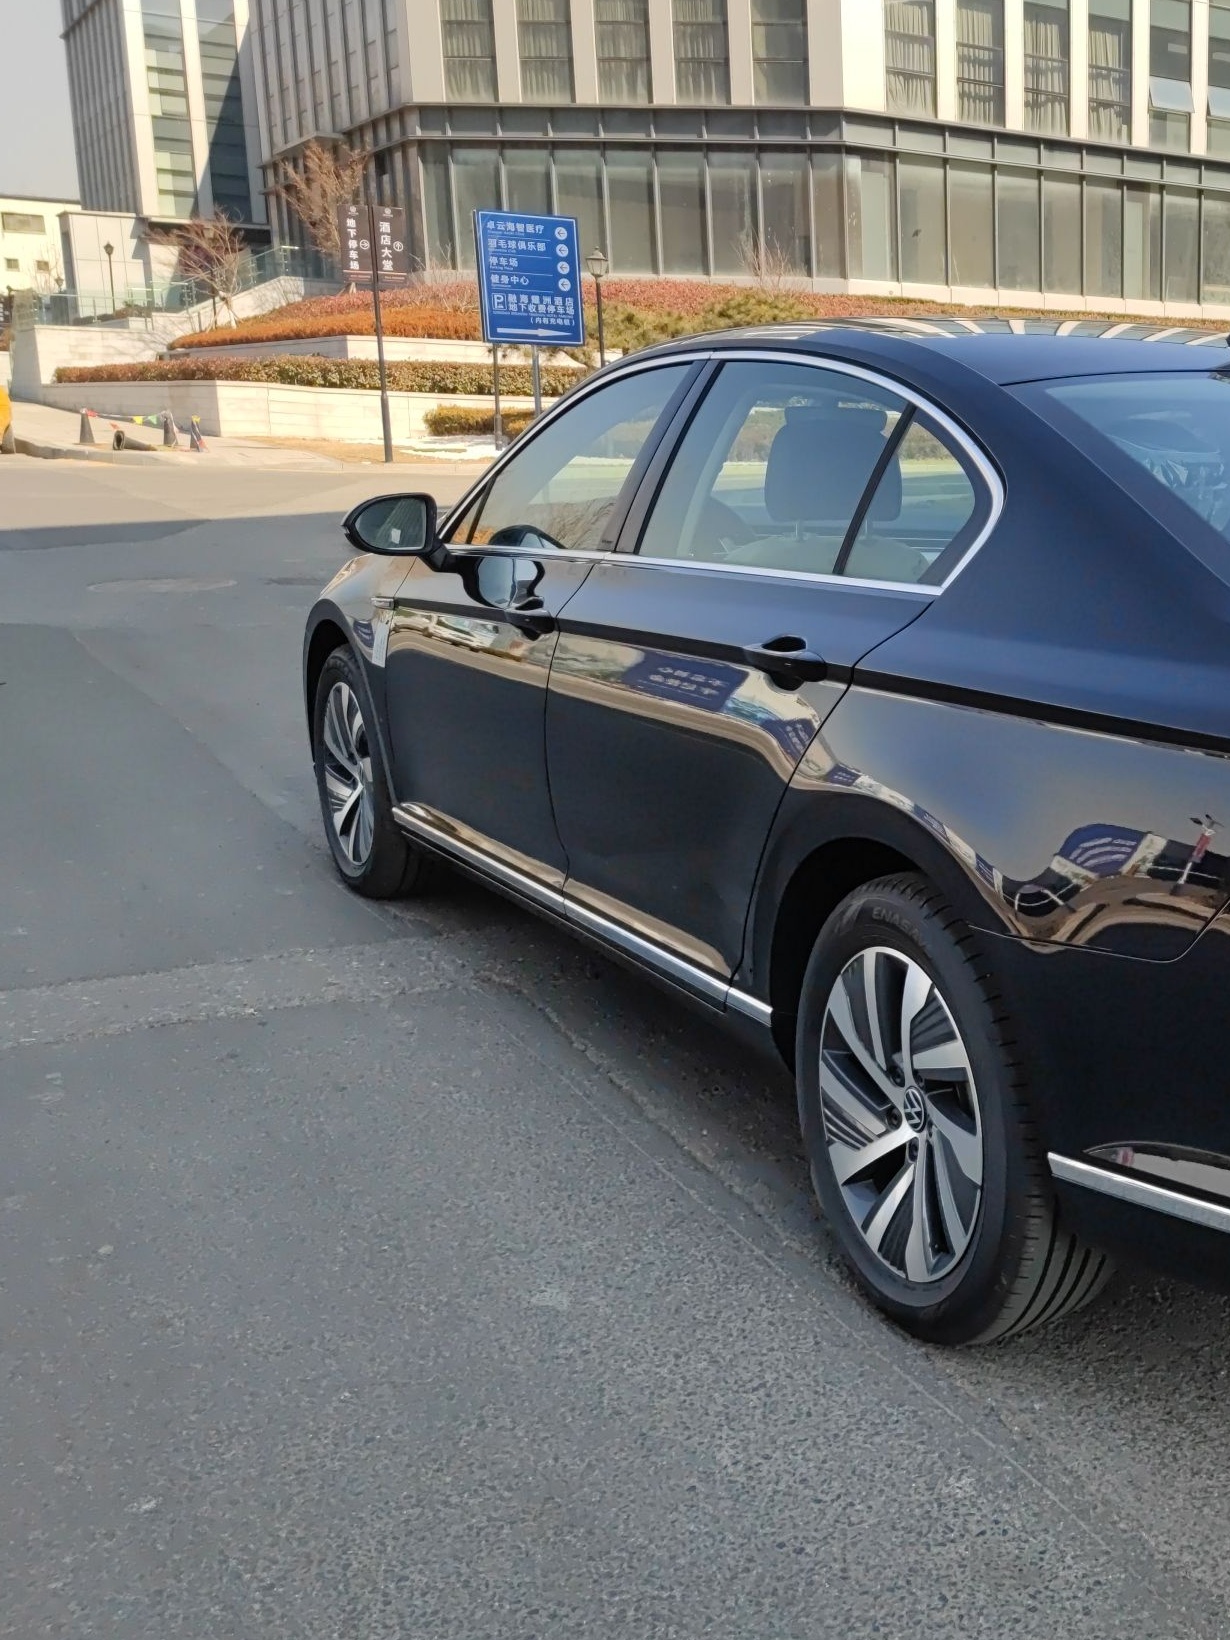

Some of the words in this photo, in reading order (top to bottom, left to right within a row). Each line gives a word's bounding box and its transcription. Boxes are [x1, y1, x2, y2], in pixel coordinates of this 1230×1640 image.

[346, 218, 360, 270] 地下停车场
[379, 221, 394, 271] 酒店大堂
[488, 238, 547, 252] 羽毛球俱乐部
[489, 256, 519, 267] 停车场
[491, 274, 530, 286] 健身中心
